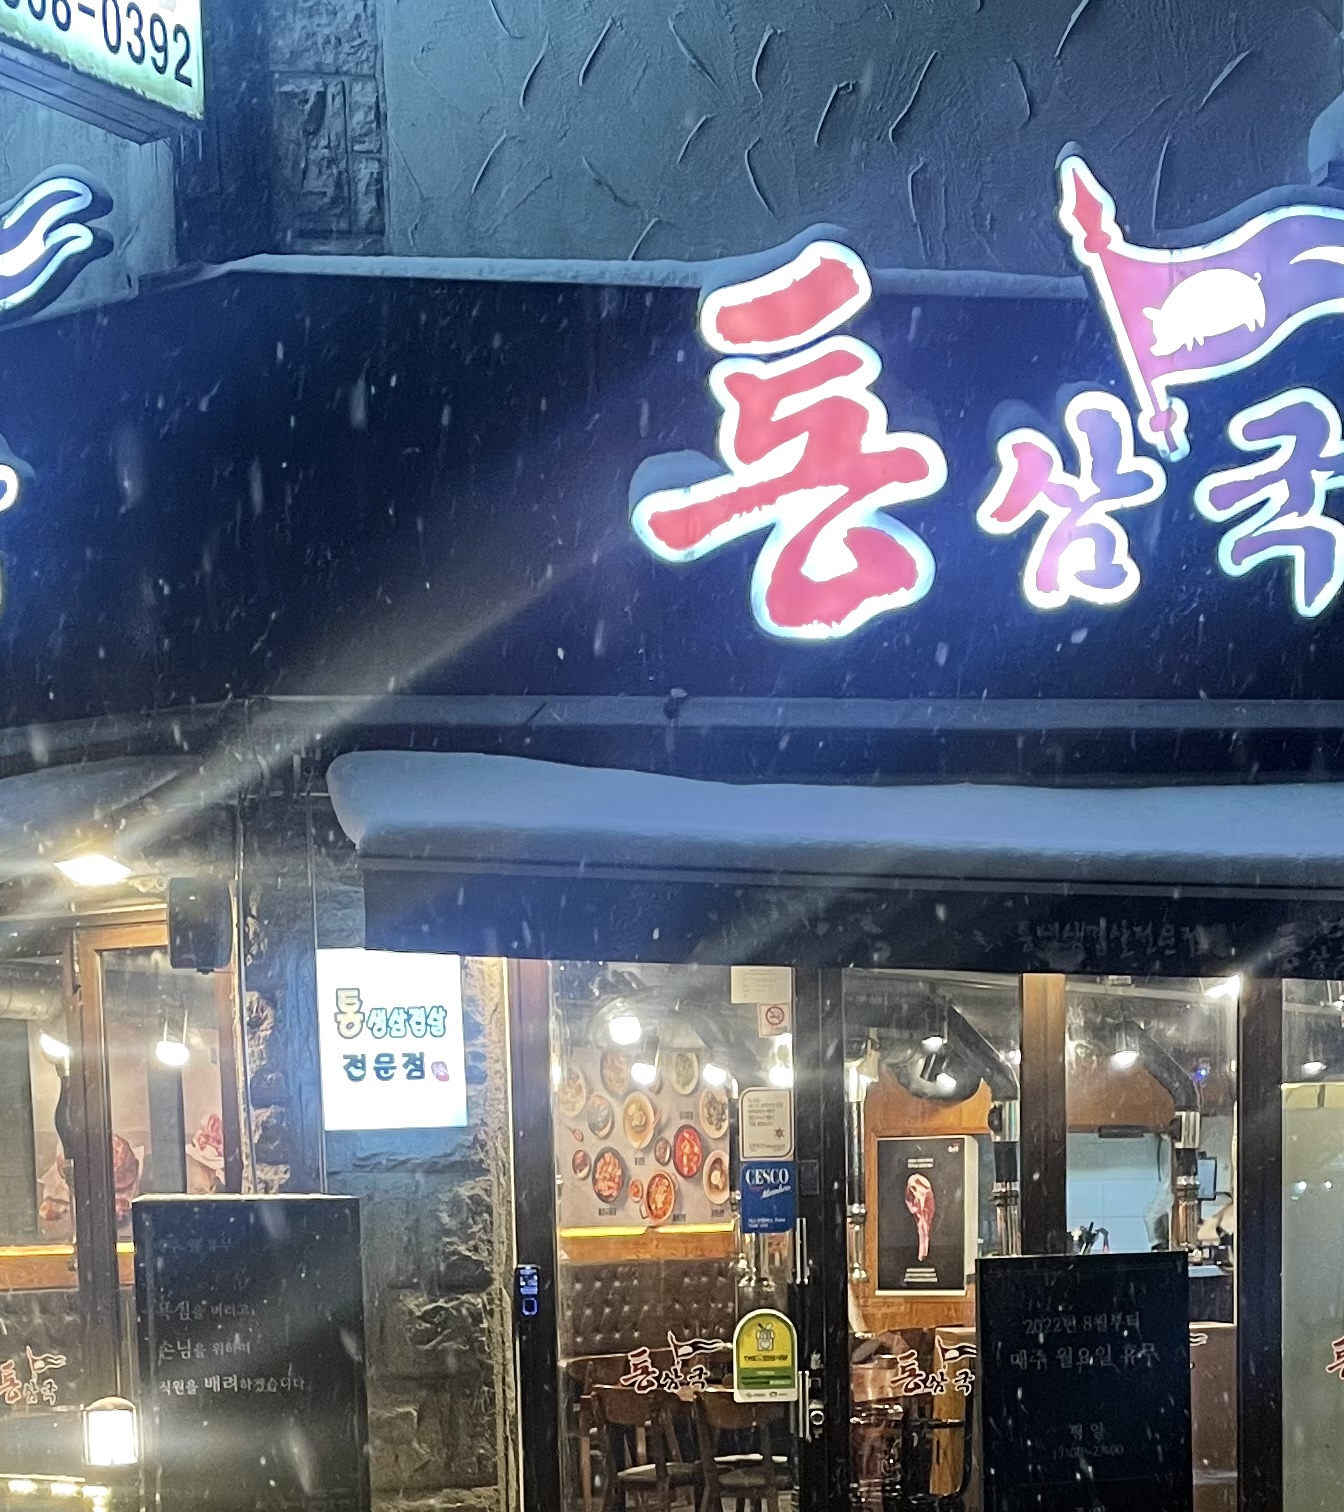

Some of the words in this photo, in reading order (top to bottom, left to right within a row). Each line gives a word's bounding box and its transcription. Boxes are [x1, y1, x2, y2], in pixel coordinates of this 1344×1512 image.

[343, 1051, 425, 1082] 전문점
[745, 1168, 789, 1185] CESCO
[158, 1339, 206, 1360] 손님을
[1010, 1348, 1048, 1371] 매주
[1056, 1344, 1117, 1371] 월요일
[620, 1346, 710, 1394] 통삼국
[890, 1349, 975, 1396] 통삼국
[159, 1379, 199, 1396] 직원을
